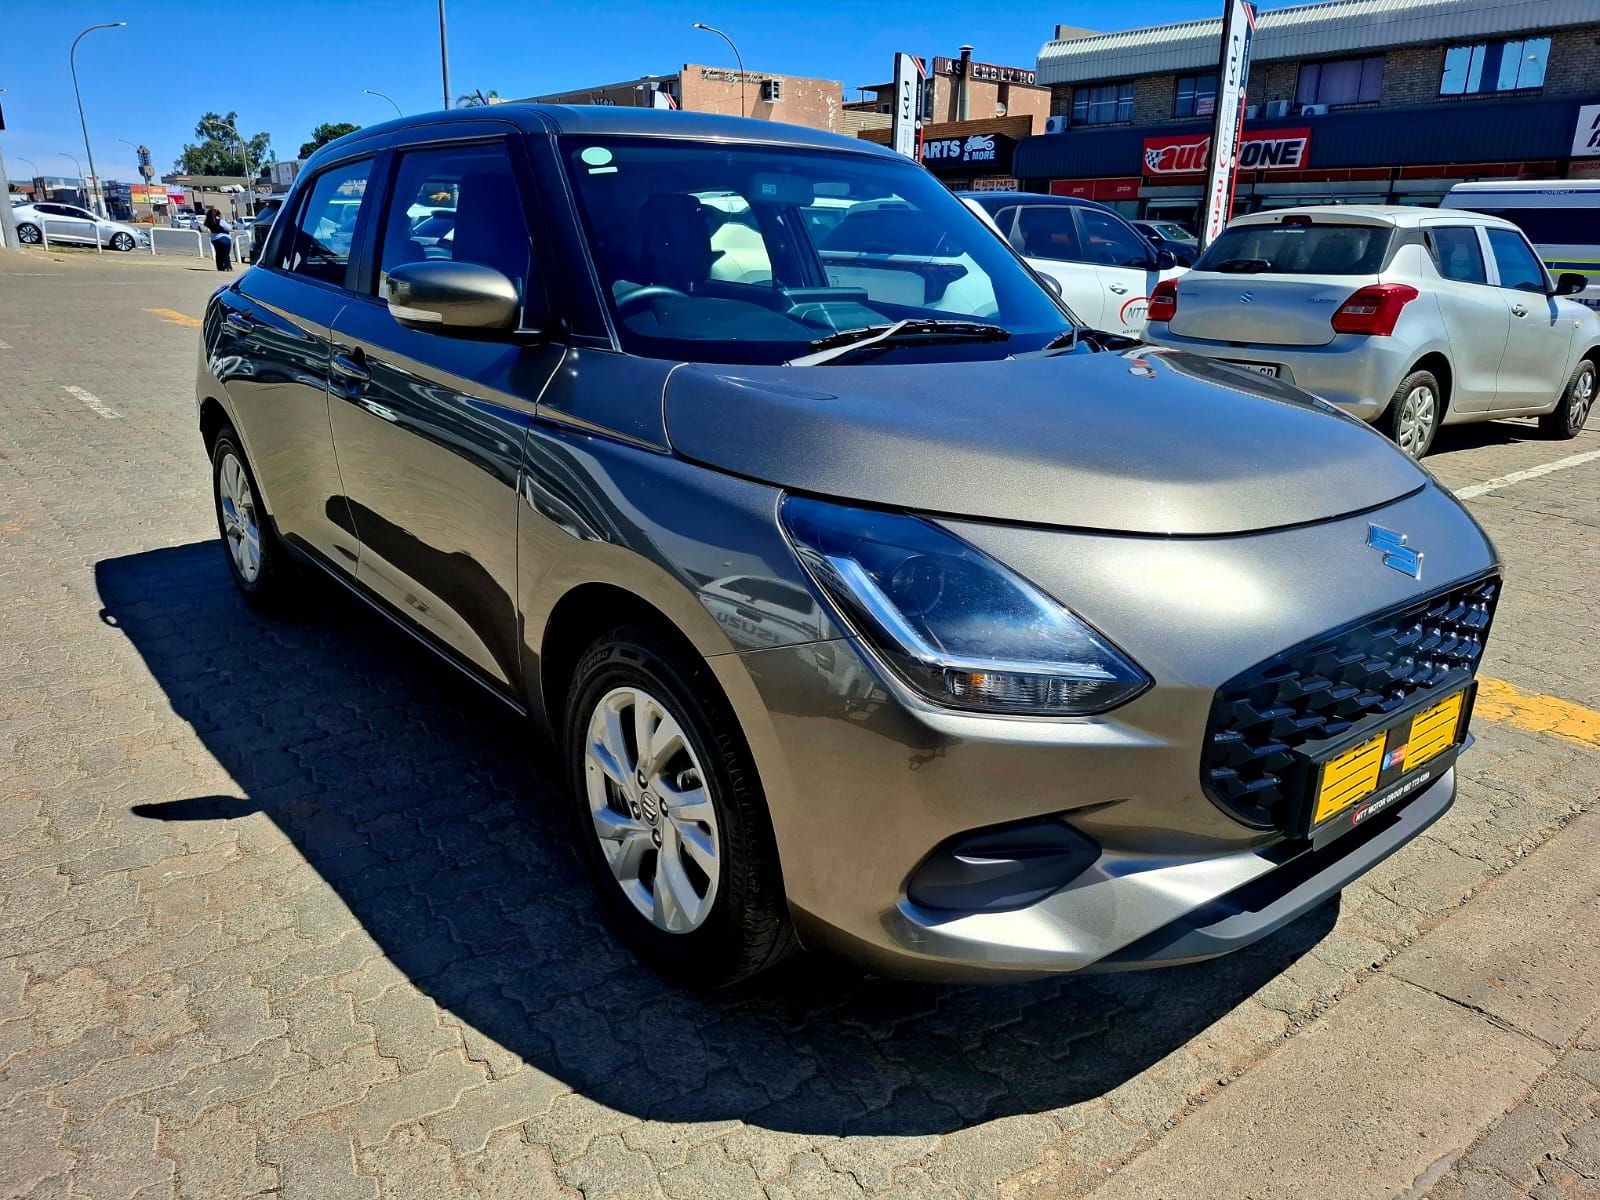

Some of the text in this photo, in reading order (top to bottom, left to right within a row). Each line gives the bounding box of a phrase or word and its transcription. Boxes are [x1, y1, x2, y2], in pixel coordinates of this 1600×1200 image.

[945, 61, 1014, 80] ASEMBLY
[922, 140, 960, 159] ARTS
[963, 150, 996, 161] & MORE
[1211, 180, 1223, 238] SUZU
[1127, 307, 1148, 319] NTT
[1368, 798, 1386, 815] MOTOR
[1386, 786, 1403, 803] GROUP
